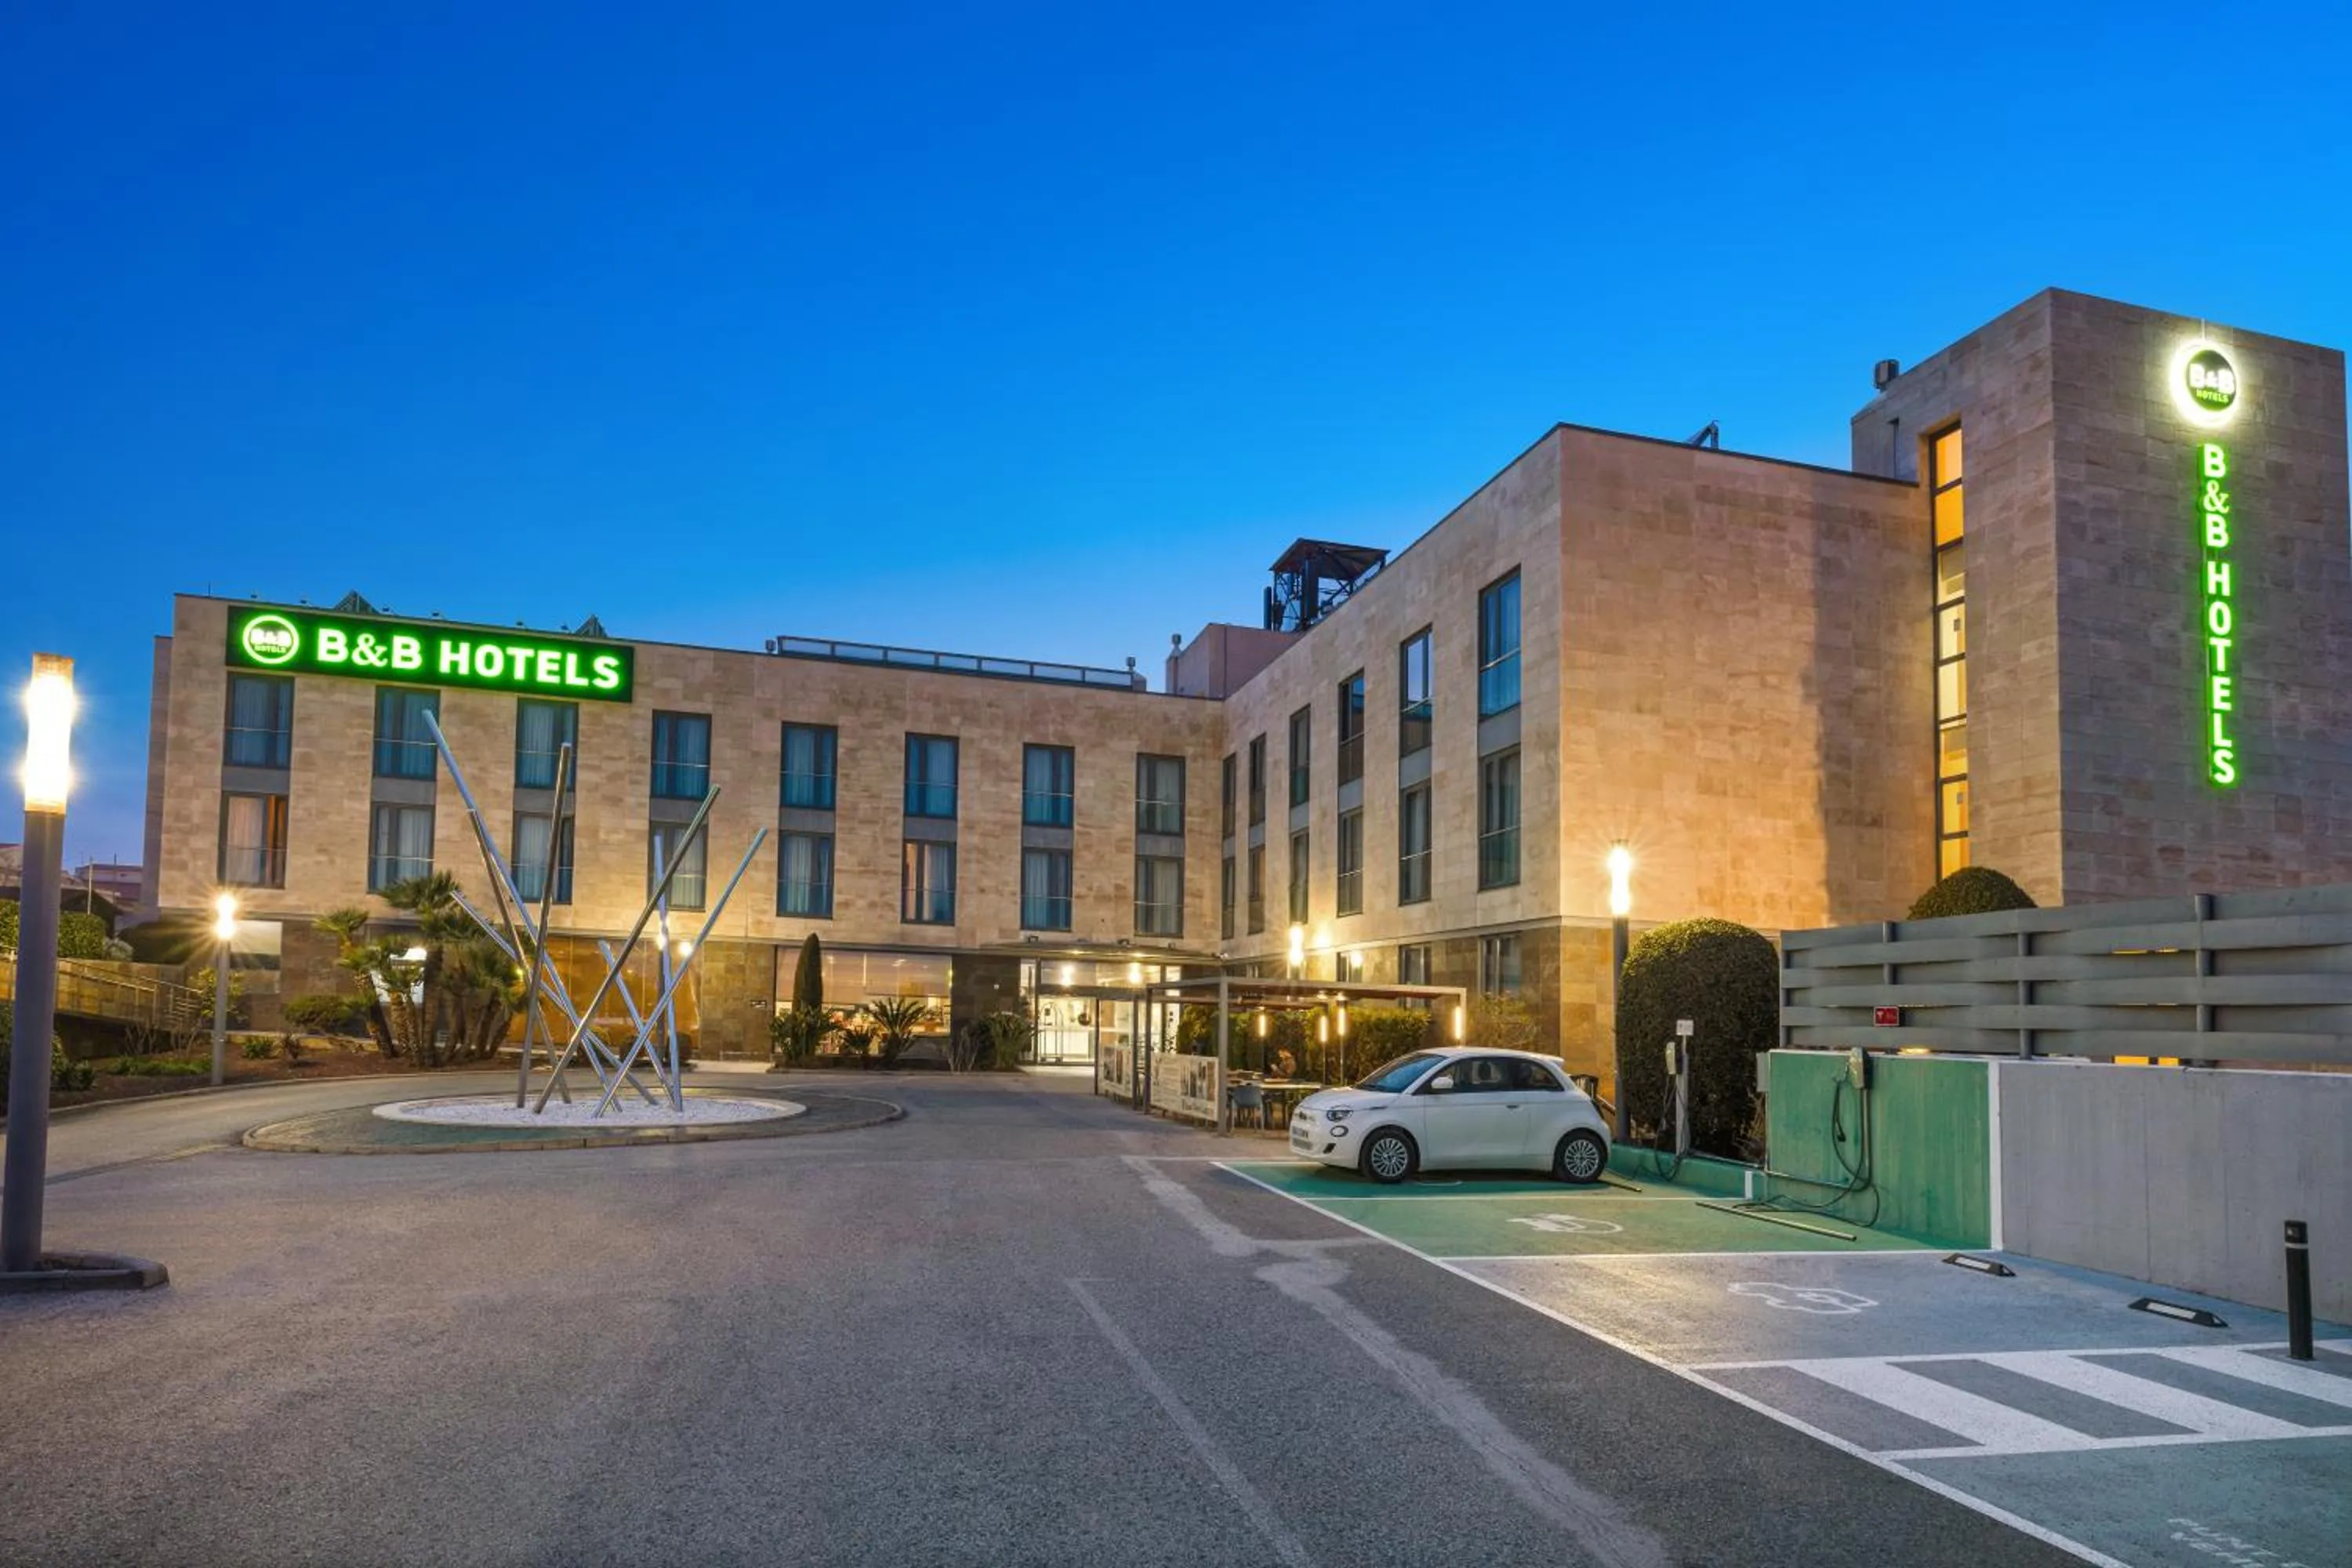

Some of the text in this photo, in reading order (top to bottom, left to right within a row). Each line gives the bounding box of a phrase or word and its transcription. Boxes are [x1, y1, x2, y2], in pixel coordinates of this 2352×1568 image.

[2189, 362, 2235, 394] B&B
[2196, 388, 2229, 403] HOTELS
[2202, 442, 2235, 784] B&B HOTELS
[317, 627, 619, 689] B&B HOTELS
